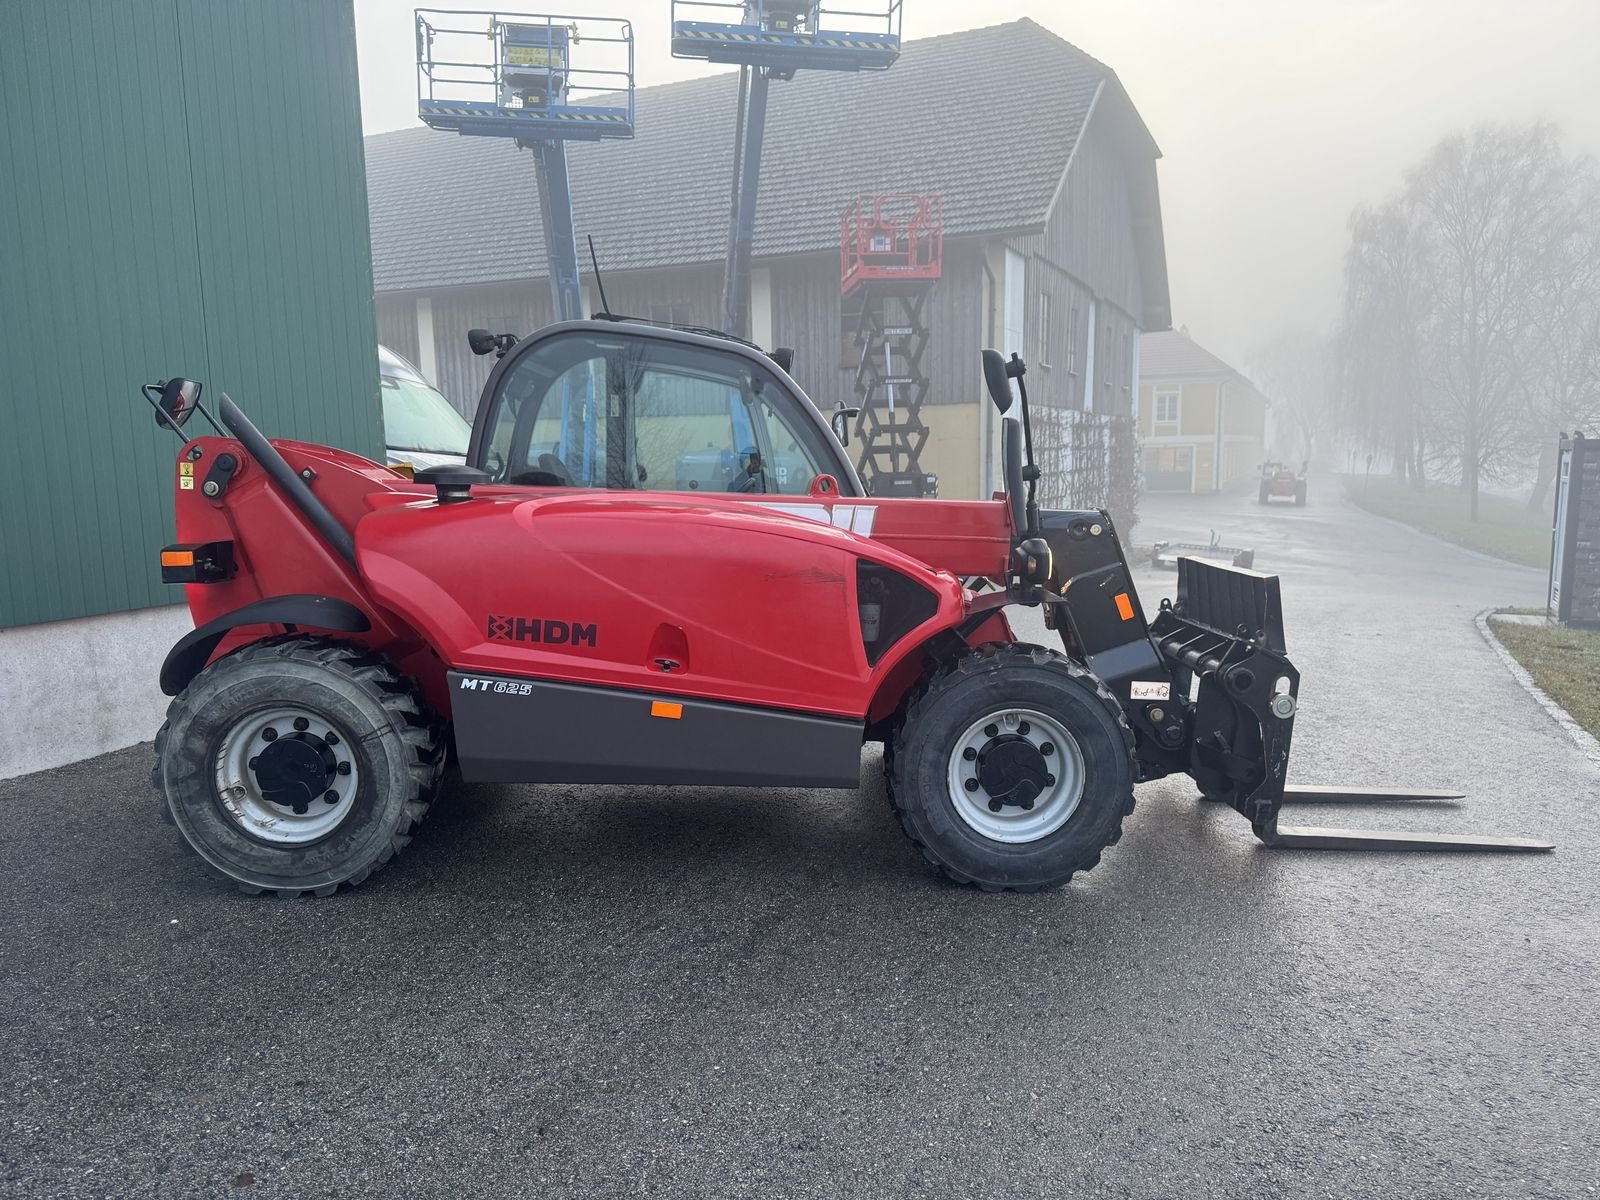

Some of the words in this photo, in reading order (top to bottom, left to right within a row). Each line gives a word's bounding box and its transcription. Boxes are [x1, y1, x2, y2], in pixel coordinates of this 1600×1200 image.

[515, 617, 597, 647] HDM
[460, 678, 493, 691] MT
[494, 681, 532, 695] 625
